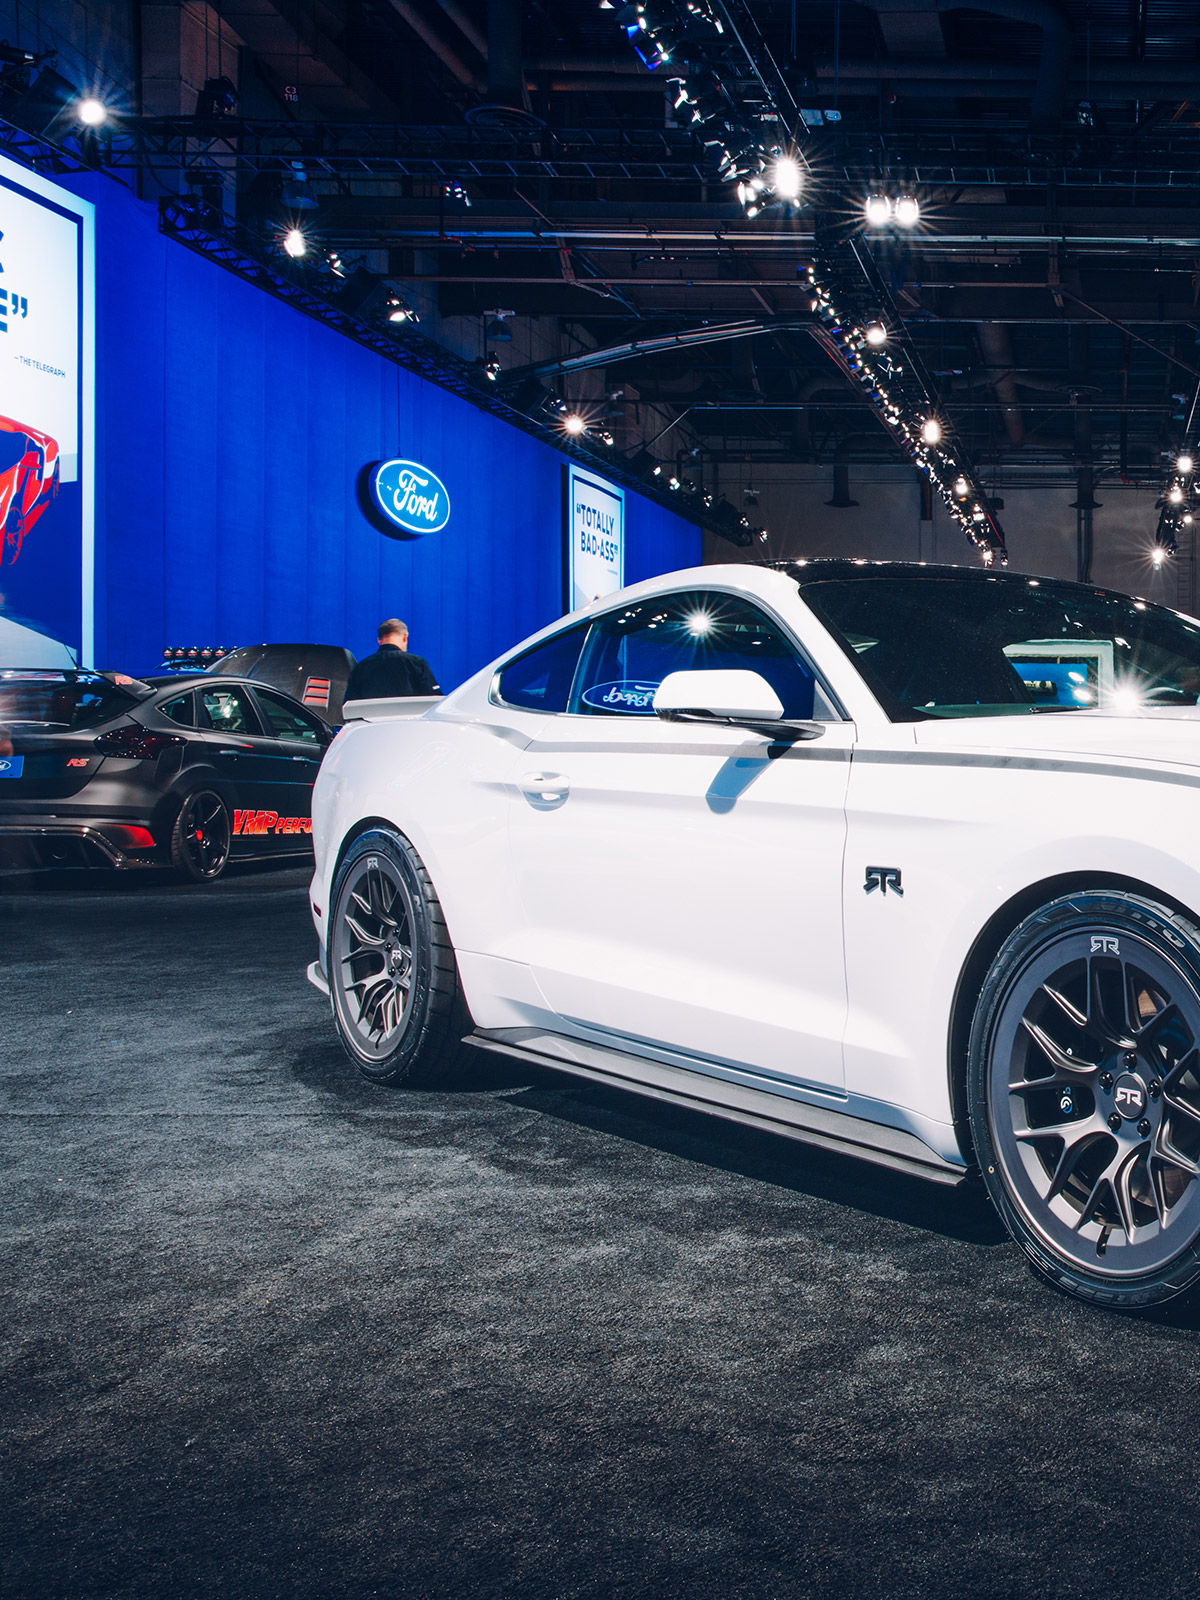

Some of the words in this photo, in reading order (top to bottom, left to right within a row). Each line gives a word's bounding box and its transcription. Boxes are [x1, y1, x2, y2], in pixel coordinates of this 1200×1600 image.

[32, 359, 66, 379] TELEGRAPH
[393, 469, 438, 522] Ford
[114, 675, 133, 686] RS
[66, 758, 90, 768] RS
[232, 809, 279, 835] VMP
